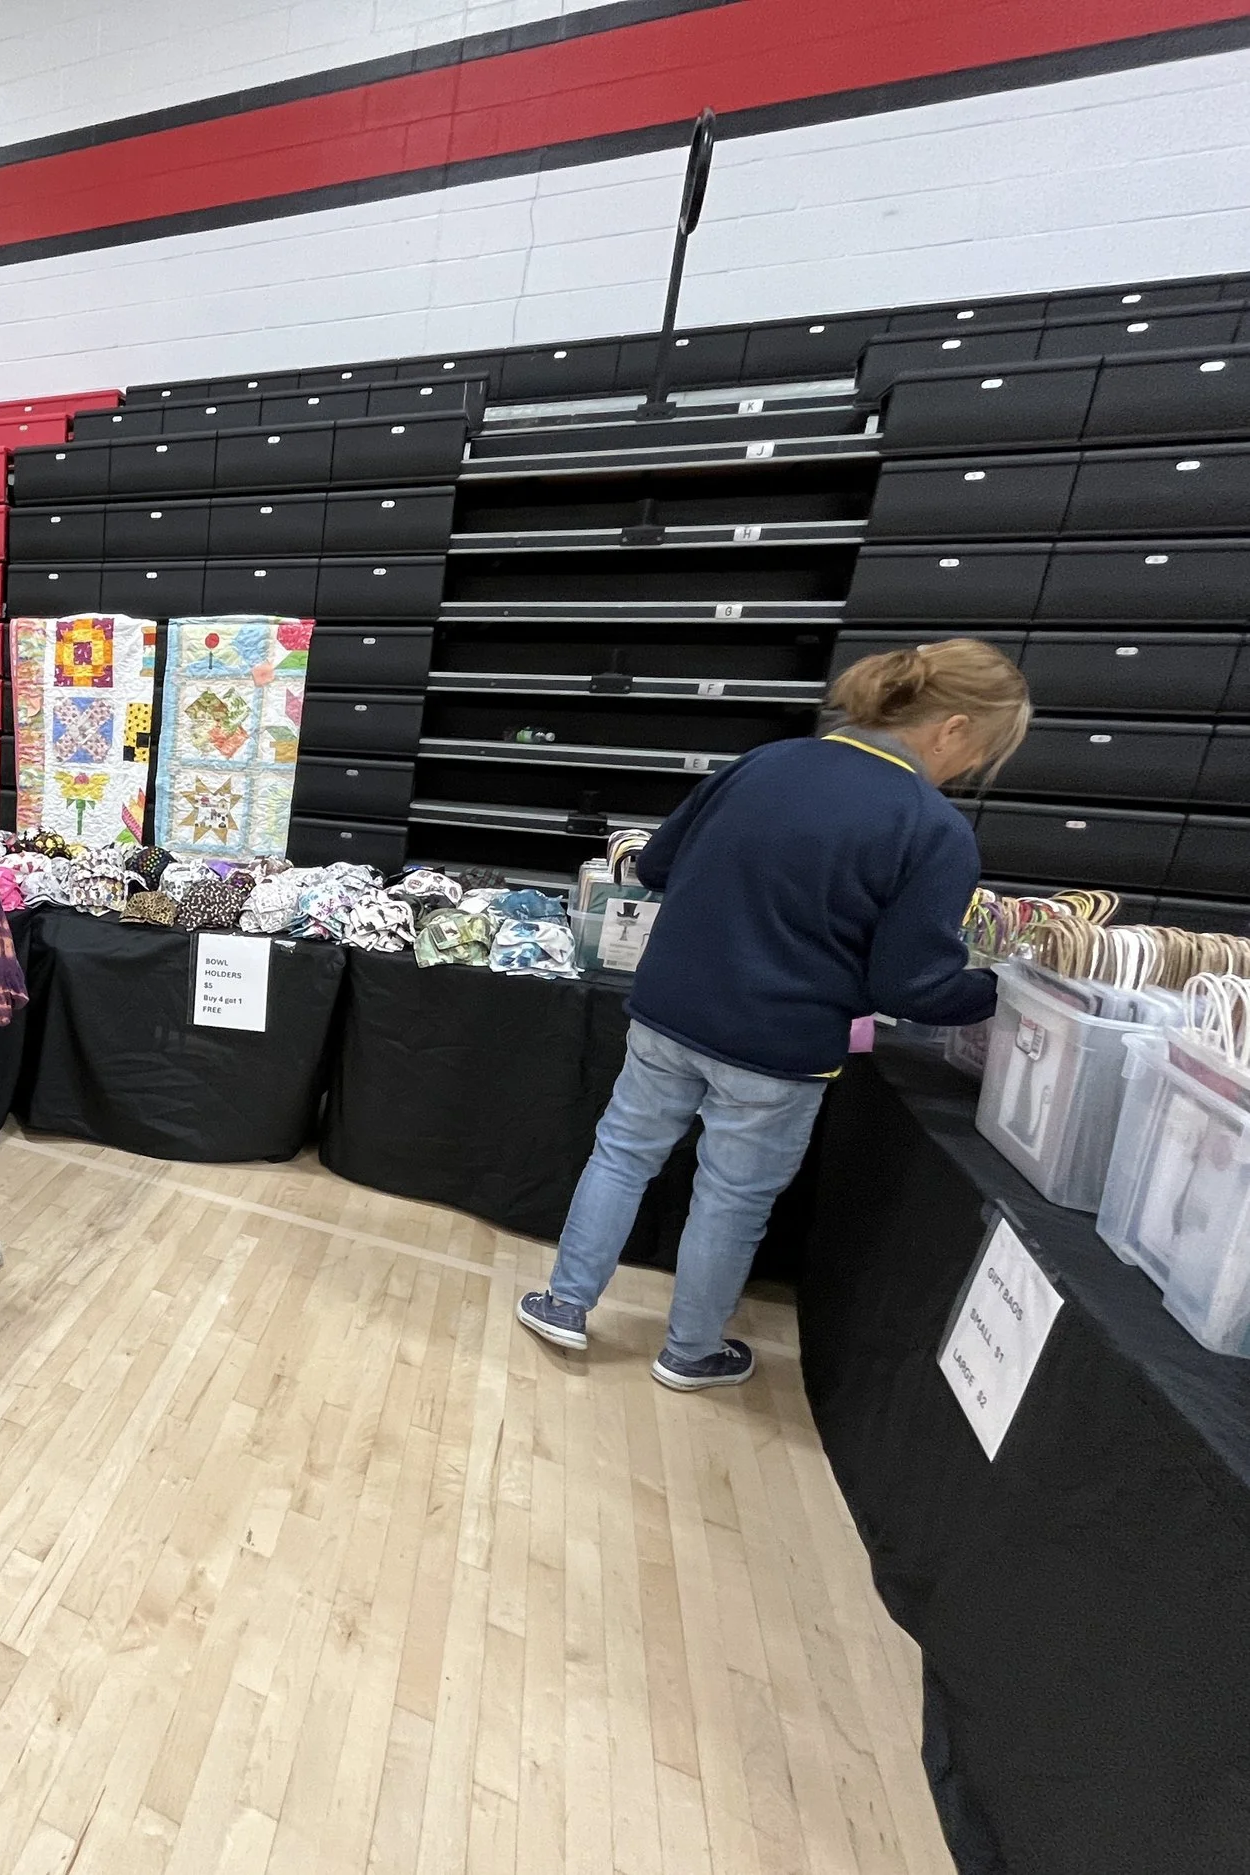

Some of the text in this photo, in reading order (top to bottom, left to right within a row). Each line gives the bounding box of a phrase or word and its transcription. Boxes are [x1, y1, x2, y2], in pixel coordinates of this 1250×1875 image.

[747, 401, 755, 411] K
[756, 445, 764, 456] J
[743, 528, 752, 539] H
[707, 683, 715, 693] F
[693, 758, 700, 768] E
[205, 958, 228, 966] BOWL
[205, 970, 242, 979] HOLDERS
[204, 995, 217, 1003] Buy
[203, 1006, 221, 1014] FREE
[988, 1267, 1023, 1321] GIFT BAGS
[969, 1307, 1005, 1363] SMALL $1
[953, 1347, 988, 1409] LARGE $2
